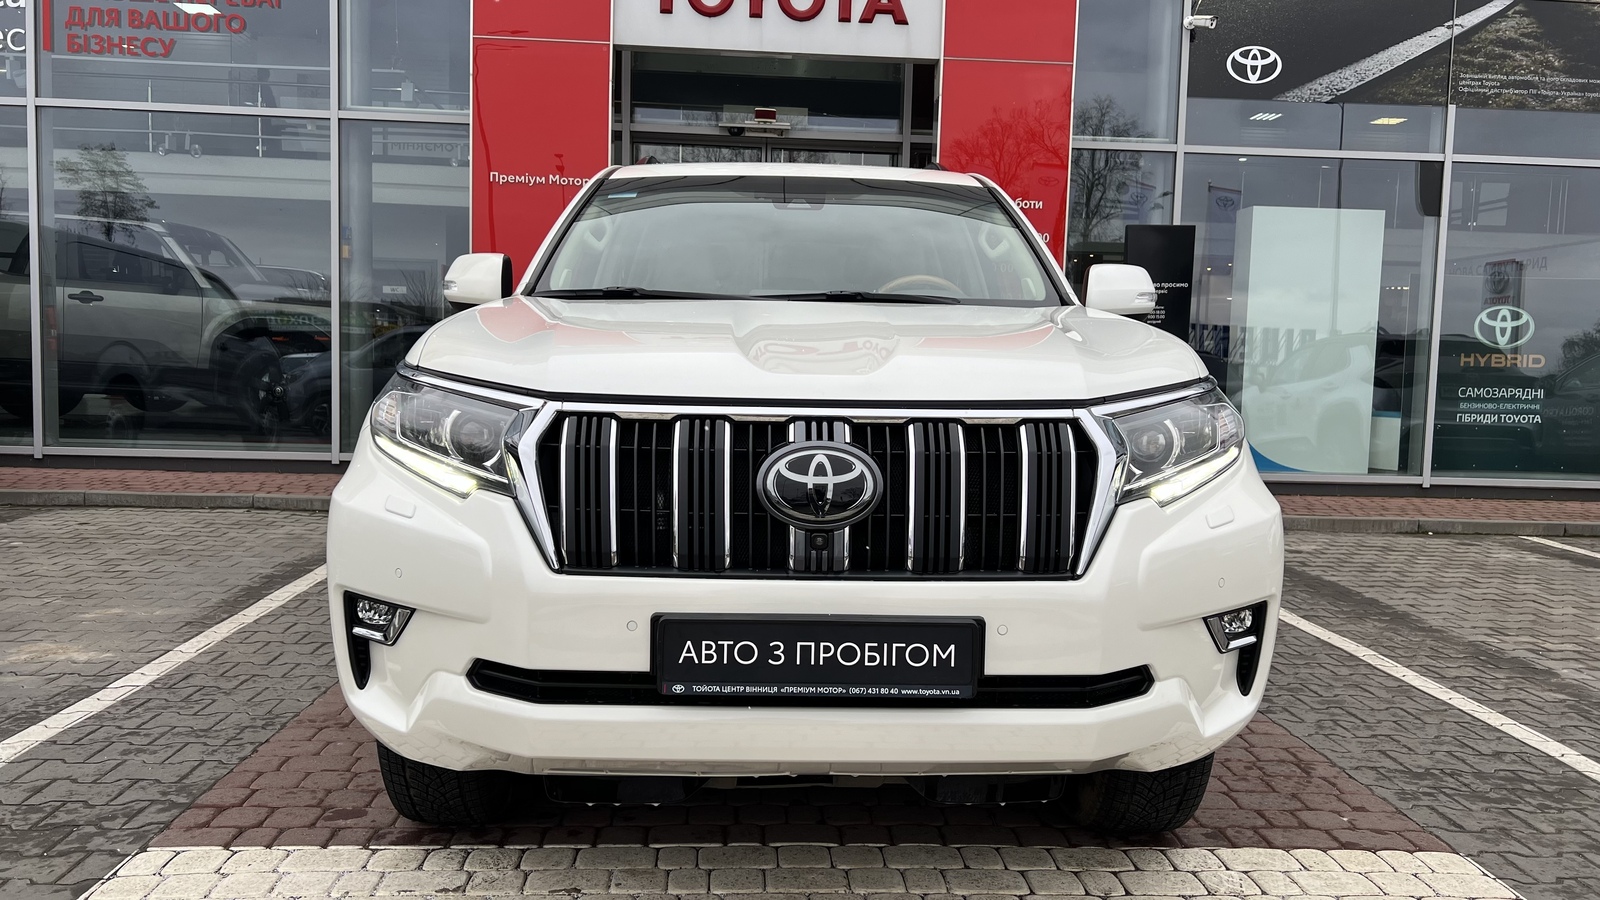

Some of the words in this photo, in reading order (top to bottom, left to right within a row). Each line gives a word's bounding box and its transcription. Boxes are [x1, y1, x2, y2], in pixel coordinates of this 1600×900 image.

[65, 6, 120, 30] ДЛЯ
[127, 8, 246, 34] ВАШОГО
[66, 33, 175, 58] БІЗНЕСУ
[489, 171, 546, 187] Преміум
[1460, 353, 1546, 368] HYBRID
[1458, 387, 1544, 400] САМОЗАРЯДНІ
[1459, 402, 1540, 410] БЕНЗИНОВО-ЕЛЕКТРИЧНІ
[1456, 413, 1498, 424] ГІБРИДИ
[1500, 414, 1542, 424] TOYOTA
[678, 640, 758, 665] АВТО
[767, 641, 785, 665] З
[796, 641, 955, 667] ПРОБІГОМ
[692, 684, 721, 693] ТОЙОТА
[721, 685, 745, 694] ЦЕНТР
[745, 686, 778, 694] ВІННИЦЯ
[780, 686, 816, 694] «ПРЕМІУМ
[848, 687, 867, 695] (067)
[880, 687, 889, 695] 80
[889, 687, 899, 695] 40
[900, 688, 960, 696] www.toyota.vn.ua
